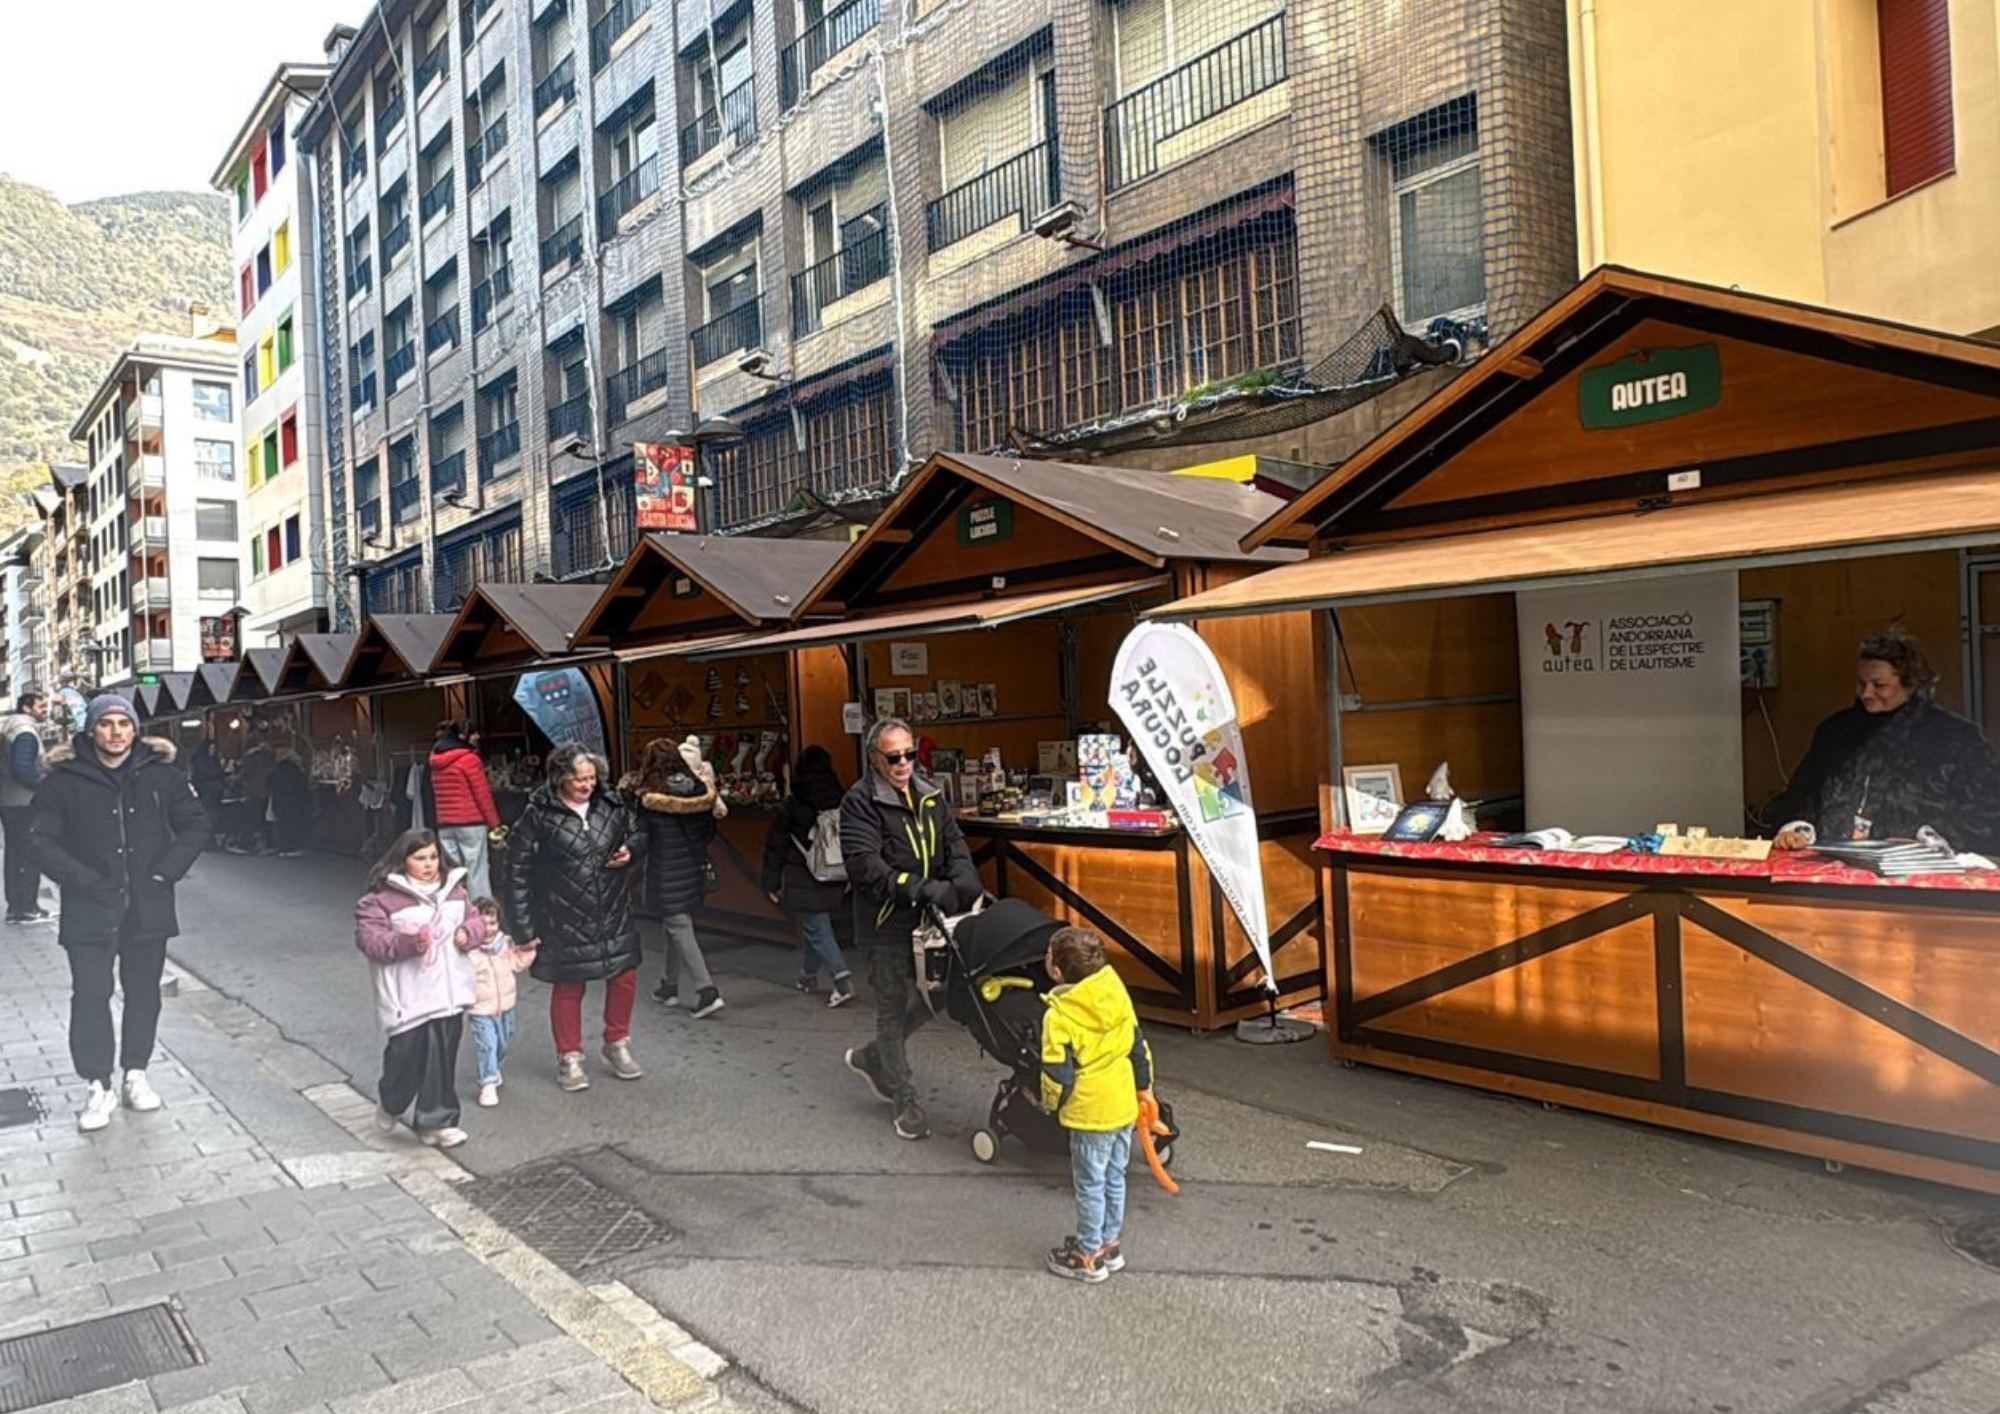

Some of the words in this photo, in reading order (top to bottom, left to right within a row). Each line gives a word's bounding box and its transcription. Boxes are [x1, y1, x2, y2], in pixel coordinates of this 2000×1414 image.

[1612, 371, 1687, 411] AUTEA
[1608, 611, 1692, 629] ASSOCIACIÓ
[1609, 628, 1693, 643] ANDORRANA
[1609, 645, 1626, 657] DE
[1629, 642, 1705, 656] L'ESPECTRE
[1543, 656, 1594, 672] autea
[1609, 658, 1627, 671] DE
[1629, 656, 1696, 670] L'AUTISME
